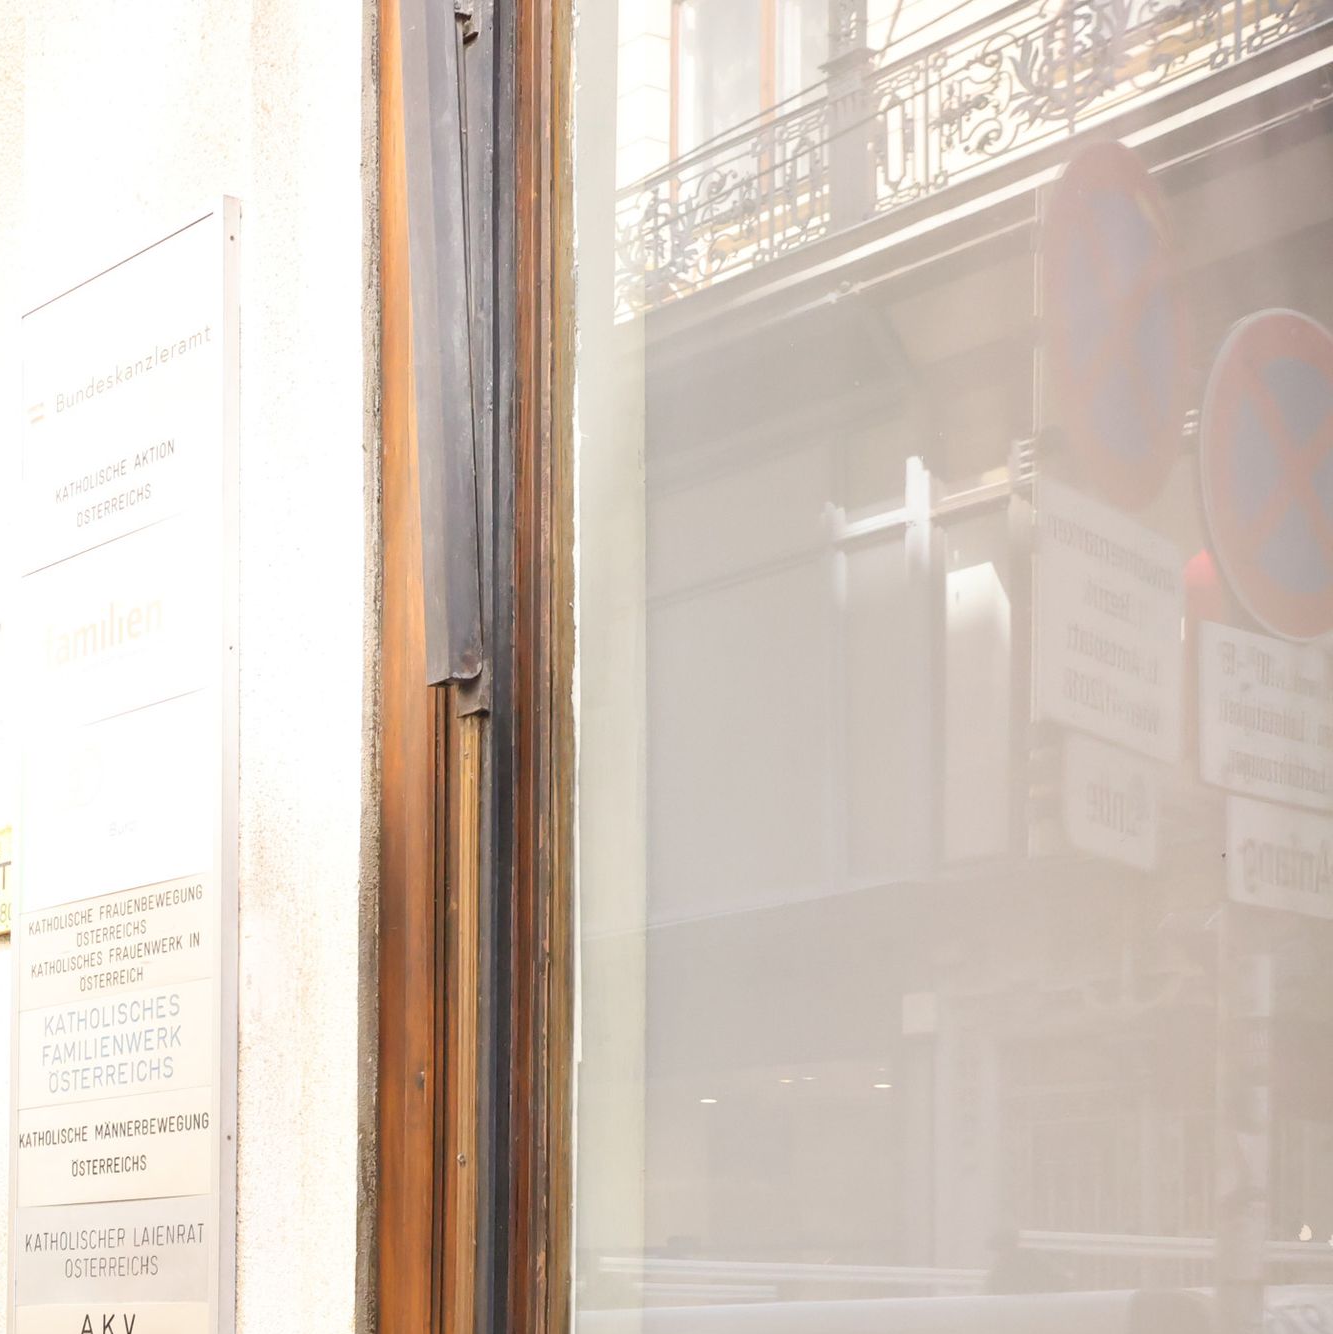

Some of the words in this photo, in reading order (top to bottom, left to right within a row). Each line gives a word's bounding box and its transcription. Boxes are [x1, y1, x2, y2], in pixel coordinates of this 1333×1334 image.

[55, 324, 212, 413] Bundeskanzleramt
[55, 458, 127, 504] KATHOLISCHE
[133, 438, 176, 471] AKTION
[28, 908, 94, 937] KATHOLISCHE
[99, 884, 203, 921] FRAUENBEWEGUNG
[31, 950, 103, 979] KATHOLISCHES
[109, 934, 183, 964] FRAUENWERK
[189, 931, 201, 948] IN
[44, 993, 181, 1038] KATHOLISCHES
[41, 1024, 182, 1066] FAMILIENWERK
[48, 1055, 174, 1094] ÖSTERREICHS
[18, 1125, 89, 1149] KATHOLISCHE
[94, 1111, 210, 1141] MÄNNERBEWEGUNG
[71, 1154, 148, 1178] ÖSTERREICHS
[25, 1227, 126, 1253] KATHOLISCHER
[133, 1222, 205, 1248] LAIENRAT
